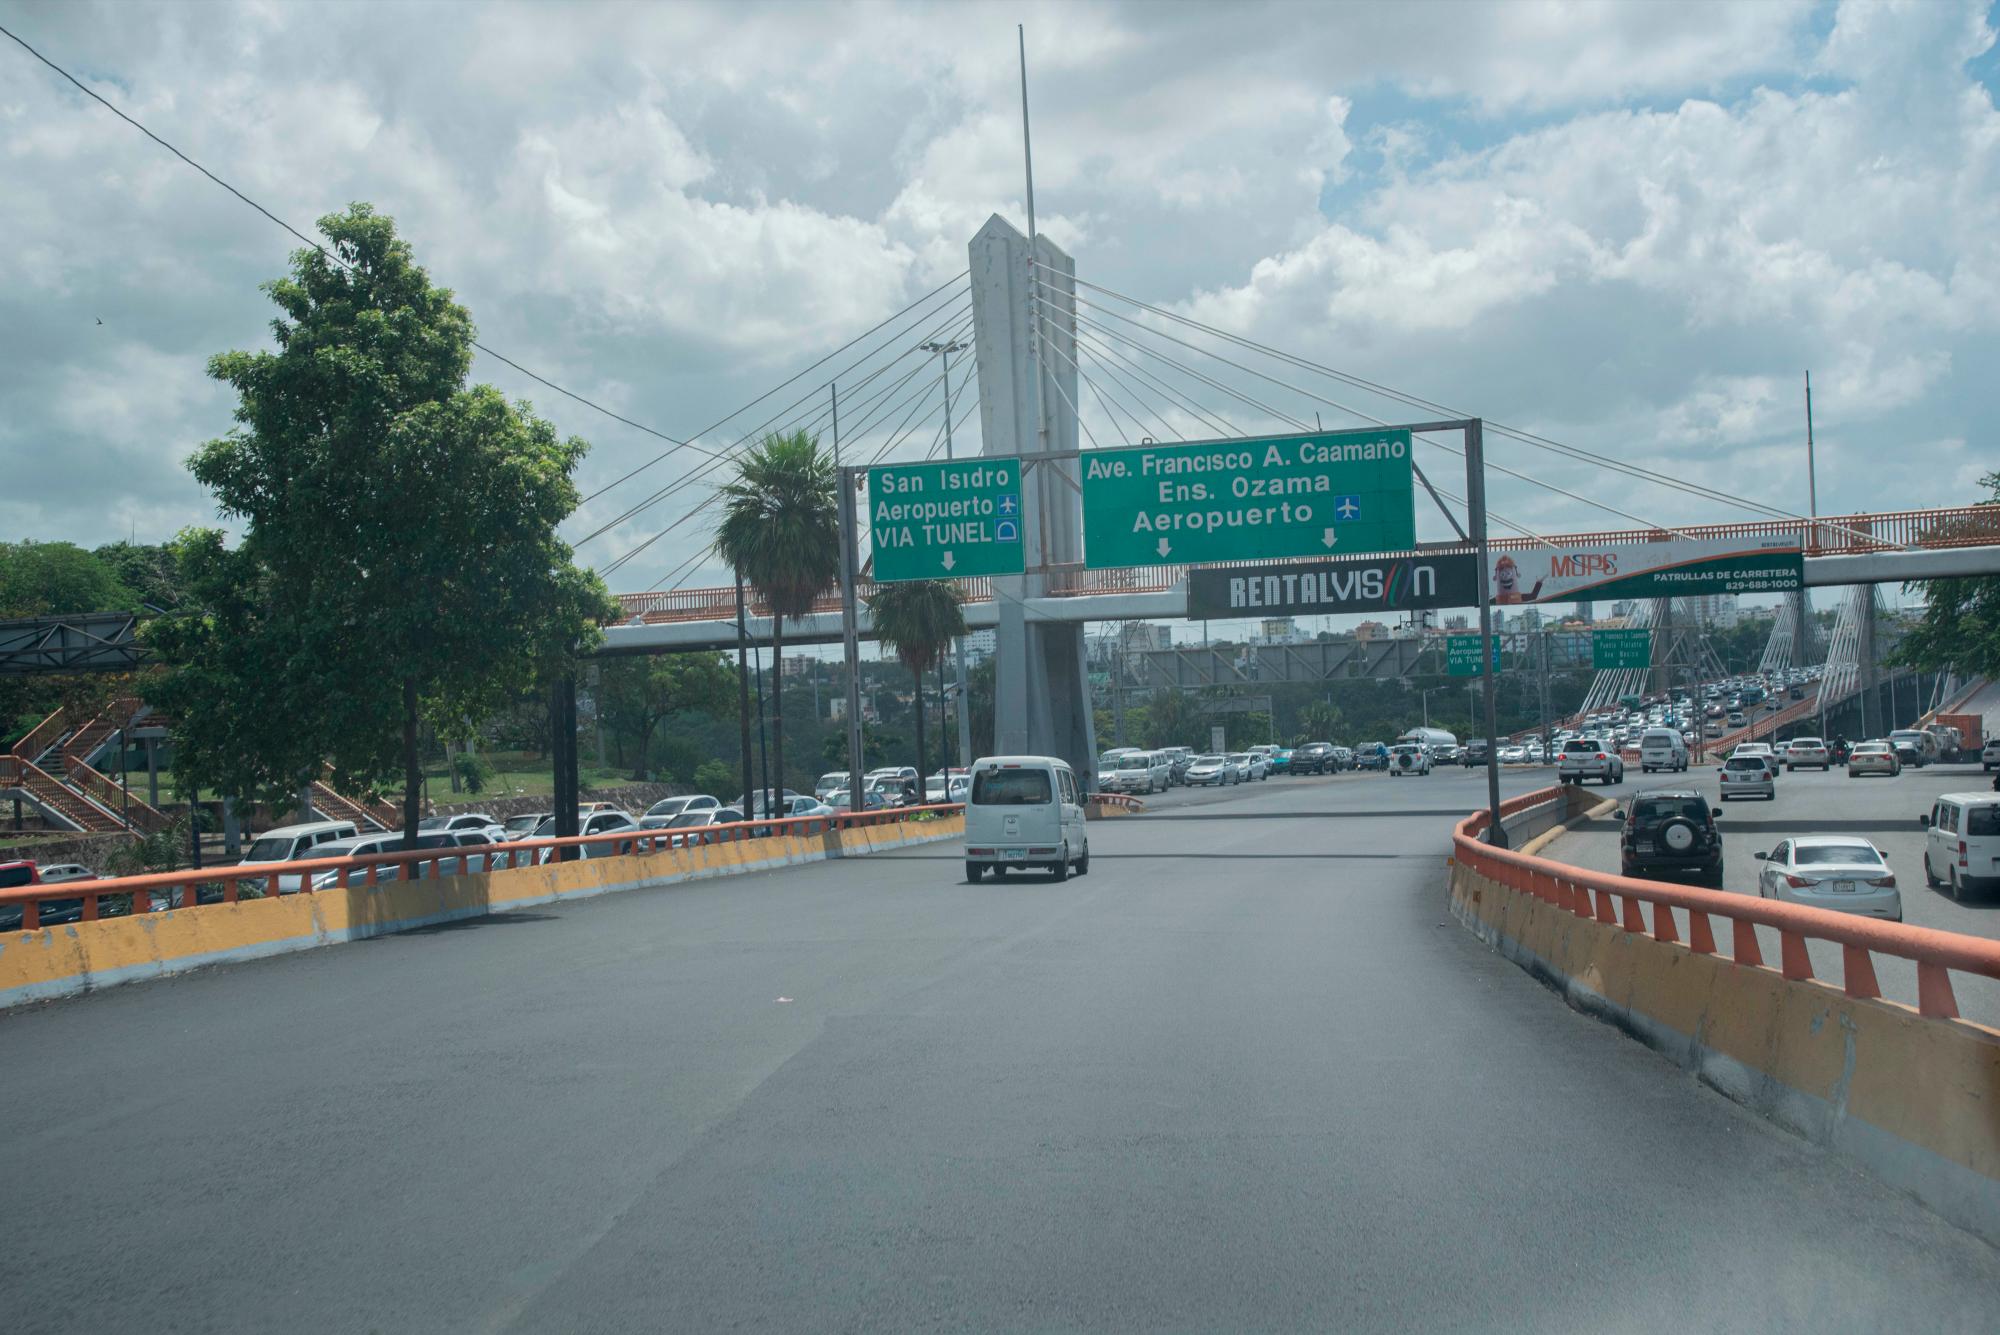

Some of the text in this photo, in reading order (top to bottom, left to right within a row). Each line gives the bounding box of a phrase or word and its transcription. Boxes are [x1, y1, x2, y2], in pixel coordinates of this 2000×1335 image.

[1086, 438, 1406, 480] Ave. Francisco A. Caamaño
[881, 466, 1009, 494] San Isidro
[1158, 474, 1330, 503] Ens. Ozama
[875, 495, 993, 523] Aeropuerto
[1132, 501, 1313, 533] Aeropuerto
[875, 521, 992, 548] VIA TUNEL
[1653, 568, 1797, 581] PATRULLAS DE CARRETERA
[1725, 579, 1798, 590] 829-688-1000
